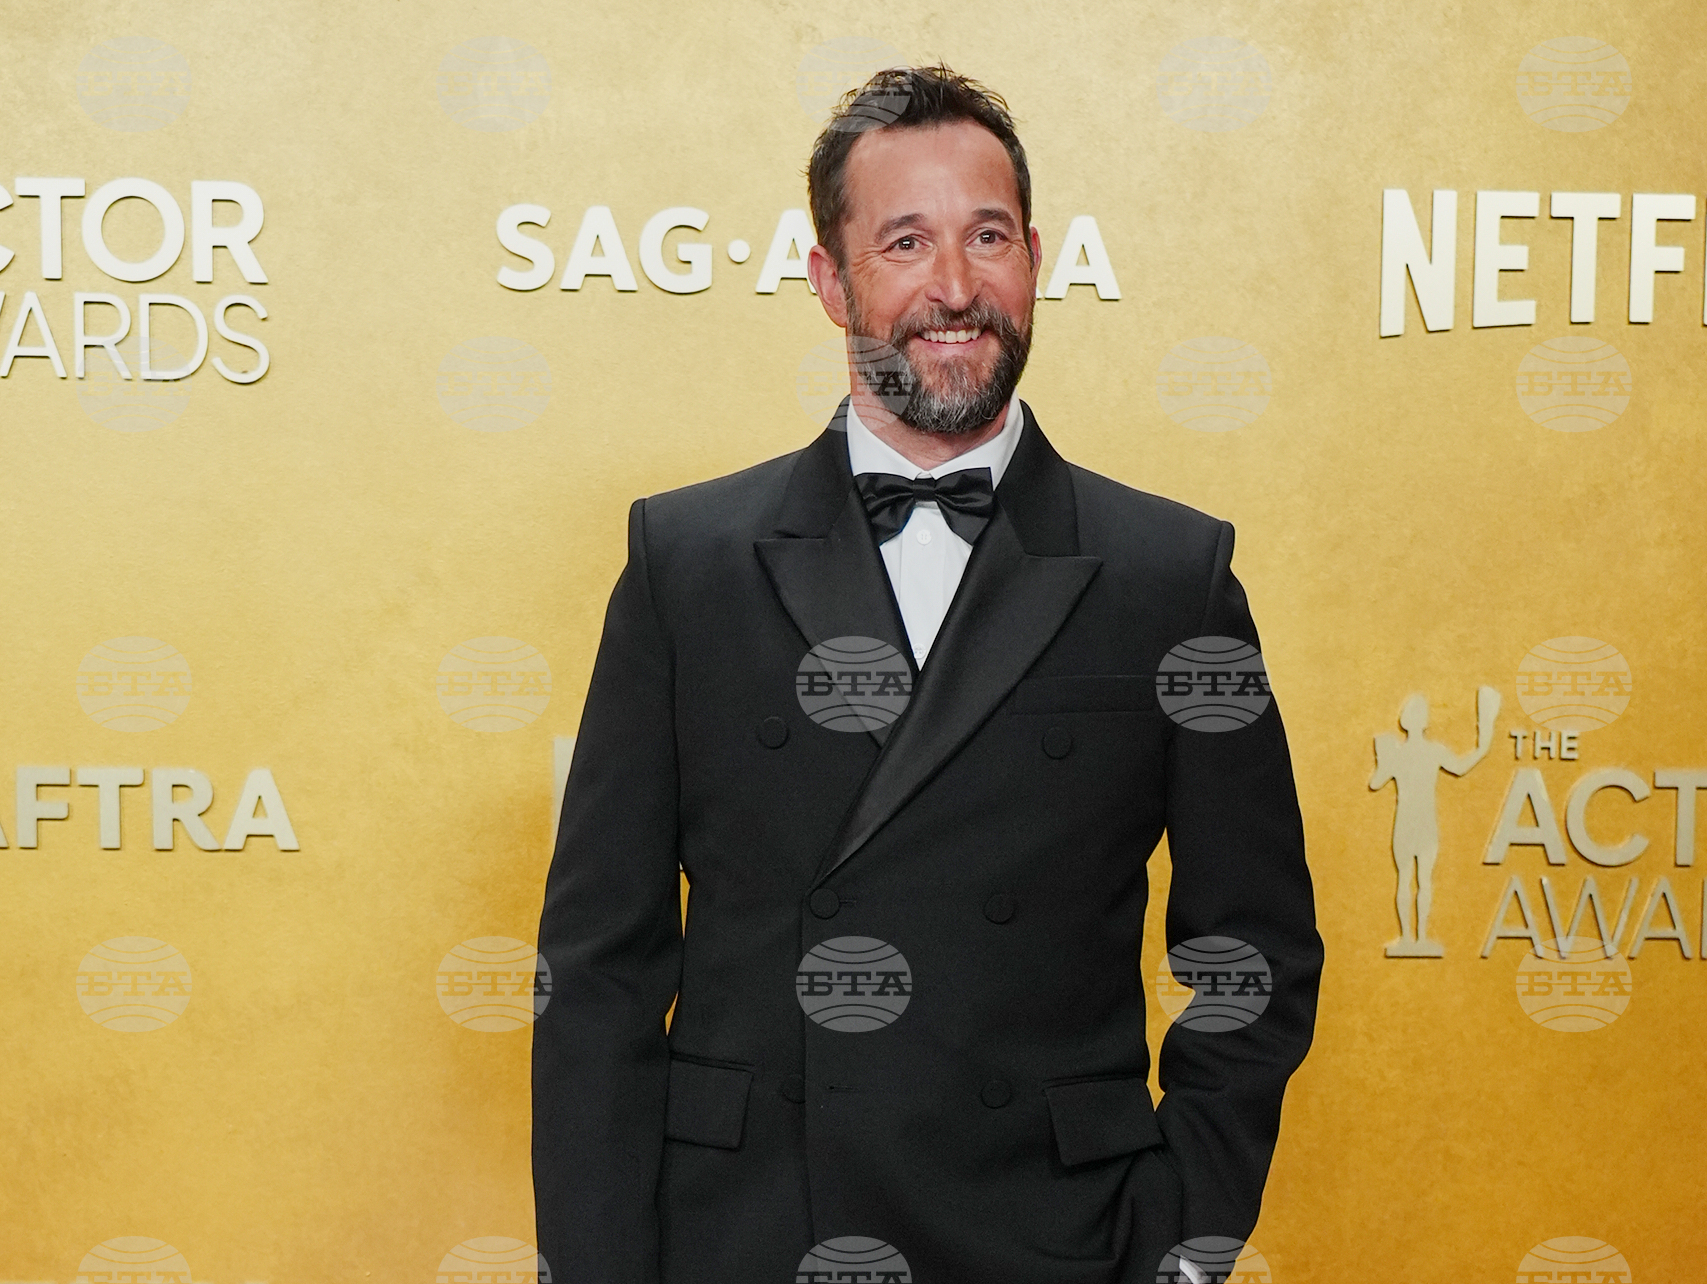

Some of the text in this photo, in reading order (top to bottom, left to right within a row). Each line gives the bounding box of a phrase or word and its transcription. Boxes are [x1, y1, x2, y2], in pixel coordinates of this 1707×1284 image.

[0, 177, 269, 284] TOR
[1380, 188, 1707, 338] NETF
[0, 291, 271, 384] ARDS
[1509, 730, 1580, 760] THE
[0, 766, 300, 851] FTRA
[1482, 768, 1707, 868] ACT
[1481, 875, 1707, 960] AWA
